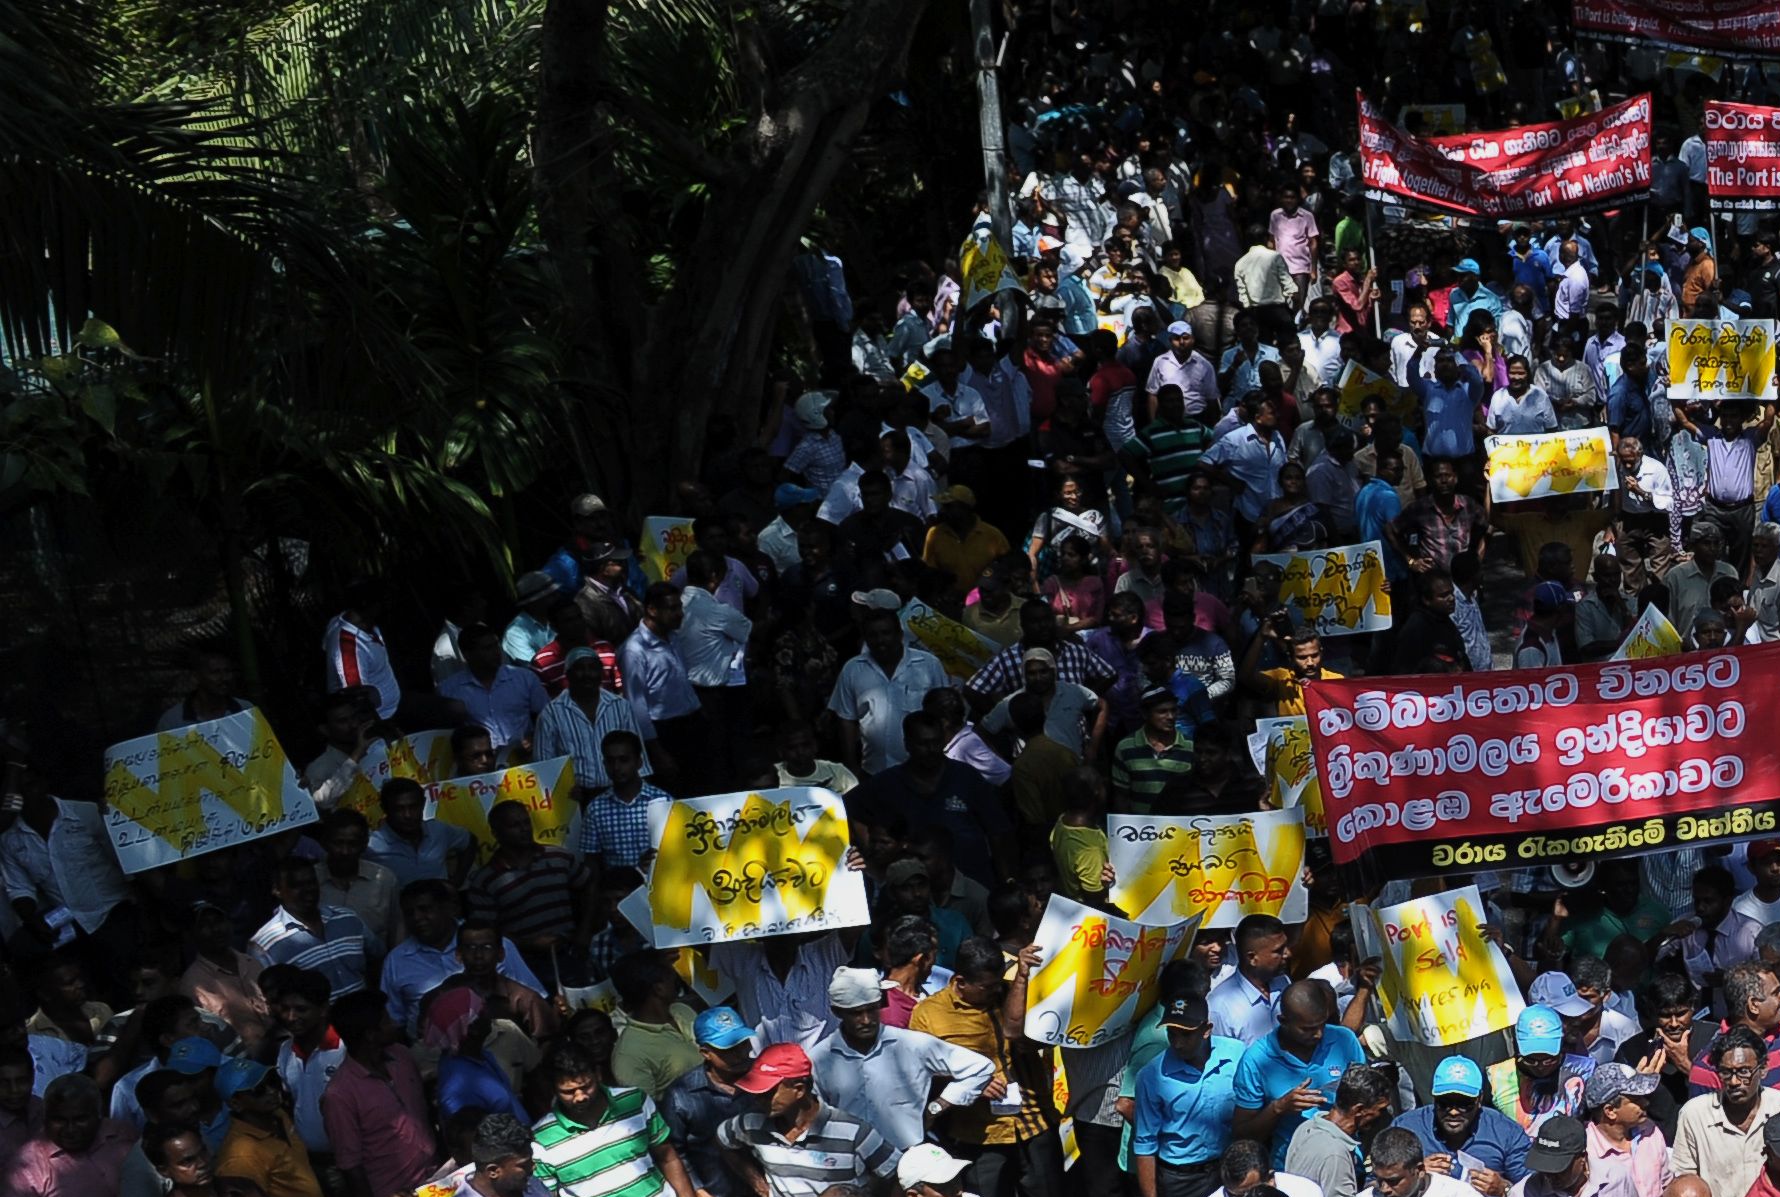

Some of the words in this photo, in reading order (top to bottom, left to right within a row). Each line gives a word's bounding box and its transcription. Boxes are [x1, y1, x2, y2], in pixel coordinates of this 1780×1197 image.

[1705, 110, 1764, 130] වරාය
[1402, 168, 1453, 198] together
[1525, 186, 1553, 208] Port
[1557, 179, 1583, 201] The
[1583, 164, 1634, 194] Nation's
[1708, 168, 1734, 187] The
[1737, 168, 1769, 187] Port
[1318, 673, 1580, 737] හම්බන්තොට
[1596, 654, 1740, 700] චීනයට
[1328, 733, 1540, 797] ත්‍රිකුණාමලය
[1555, 701, 1746, 766] ඉන්දියාවට
[469, 775, 512, 797] Port
[518, 774, 536, 790] is
[1337, 790, 1471, 843] කොළඹ
[1489, 755, 1745, 822] ඇමෙරිකාවට
[1433, 842, 1507, 866] වරාය
[1518, 818, 1666, 861] රැකගැනීමේ
[1676, 808, 1776, 842] වෘත්තීය
[1384, 909, 1433, 945] Port
[1415, 932, 1467, 973] Sold
